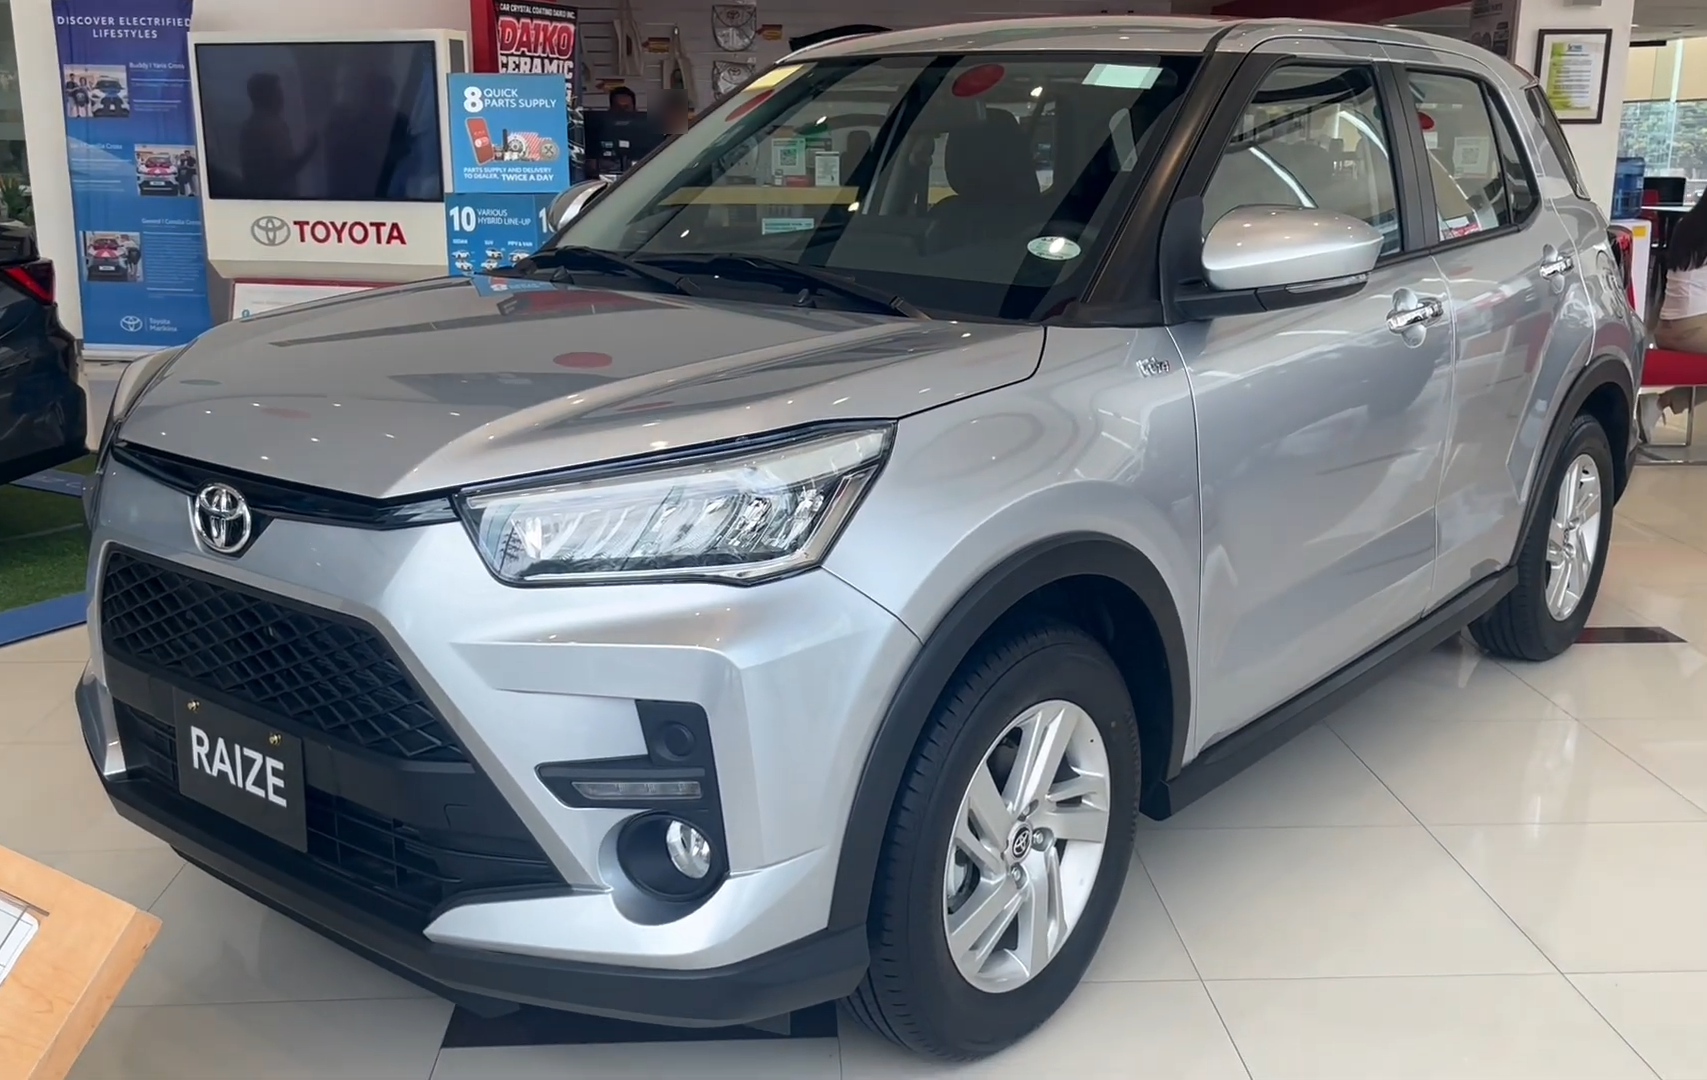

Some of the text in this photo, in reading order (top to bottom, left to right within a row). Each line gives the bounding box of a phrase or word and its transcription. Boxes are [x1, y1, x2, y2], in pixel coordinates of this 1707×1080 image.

[500, 3, 510, 11] CAR
[57, 16, 115, 26] DISCOVER
[93, 29, 158, 39] LIFESTYLES
[498, 16, 575, 59] DAIKO
[500, 55, 574, 79] CERAMIC
[483, 88, 519, 98] QUICK
[463, 86, 484, 113] 8
[484, 99, 557, 108] PARTS SUPPLY
[477, 209, 508, 217] VARIOUS
[449, 206, 476, 232] 10
[478, 217, 532, 226] HYBRID LINE-UP
[293, 220, 407, 245] TOYOTA
[190, 725, 287, 808] RAIZE
